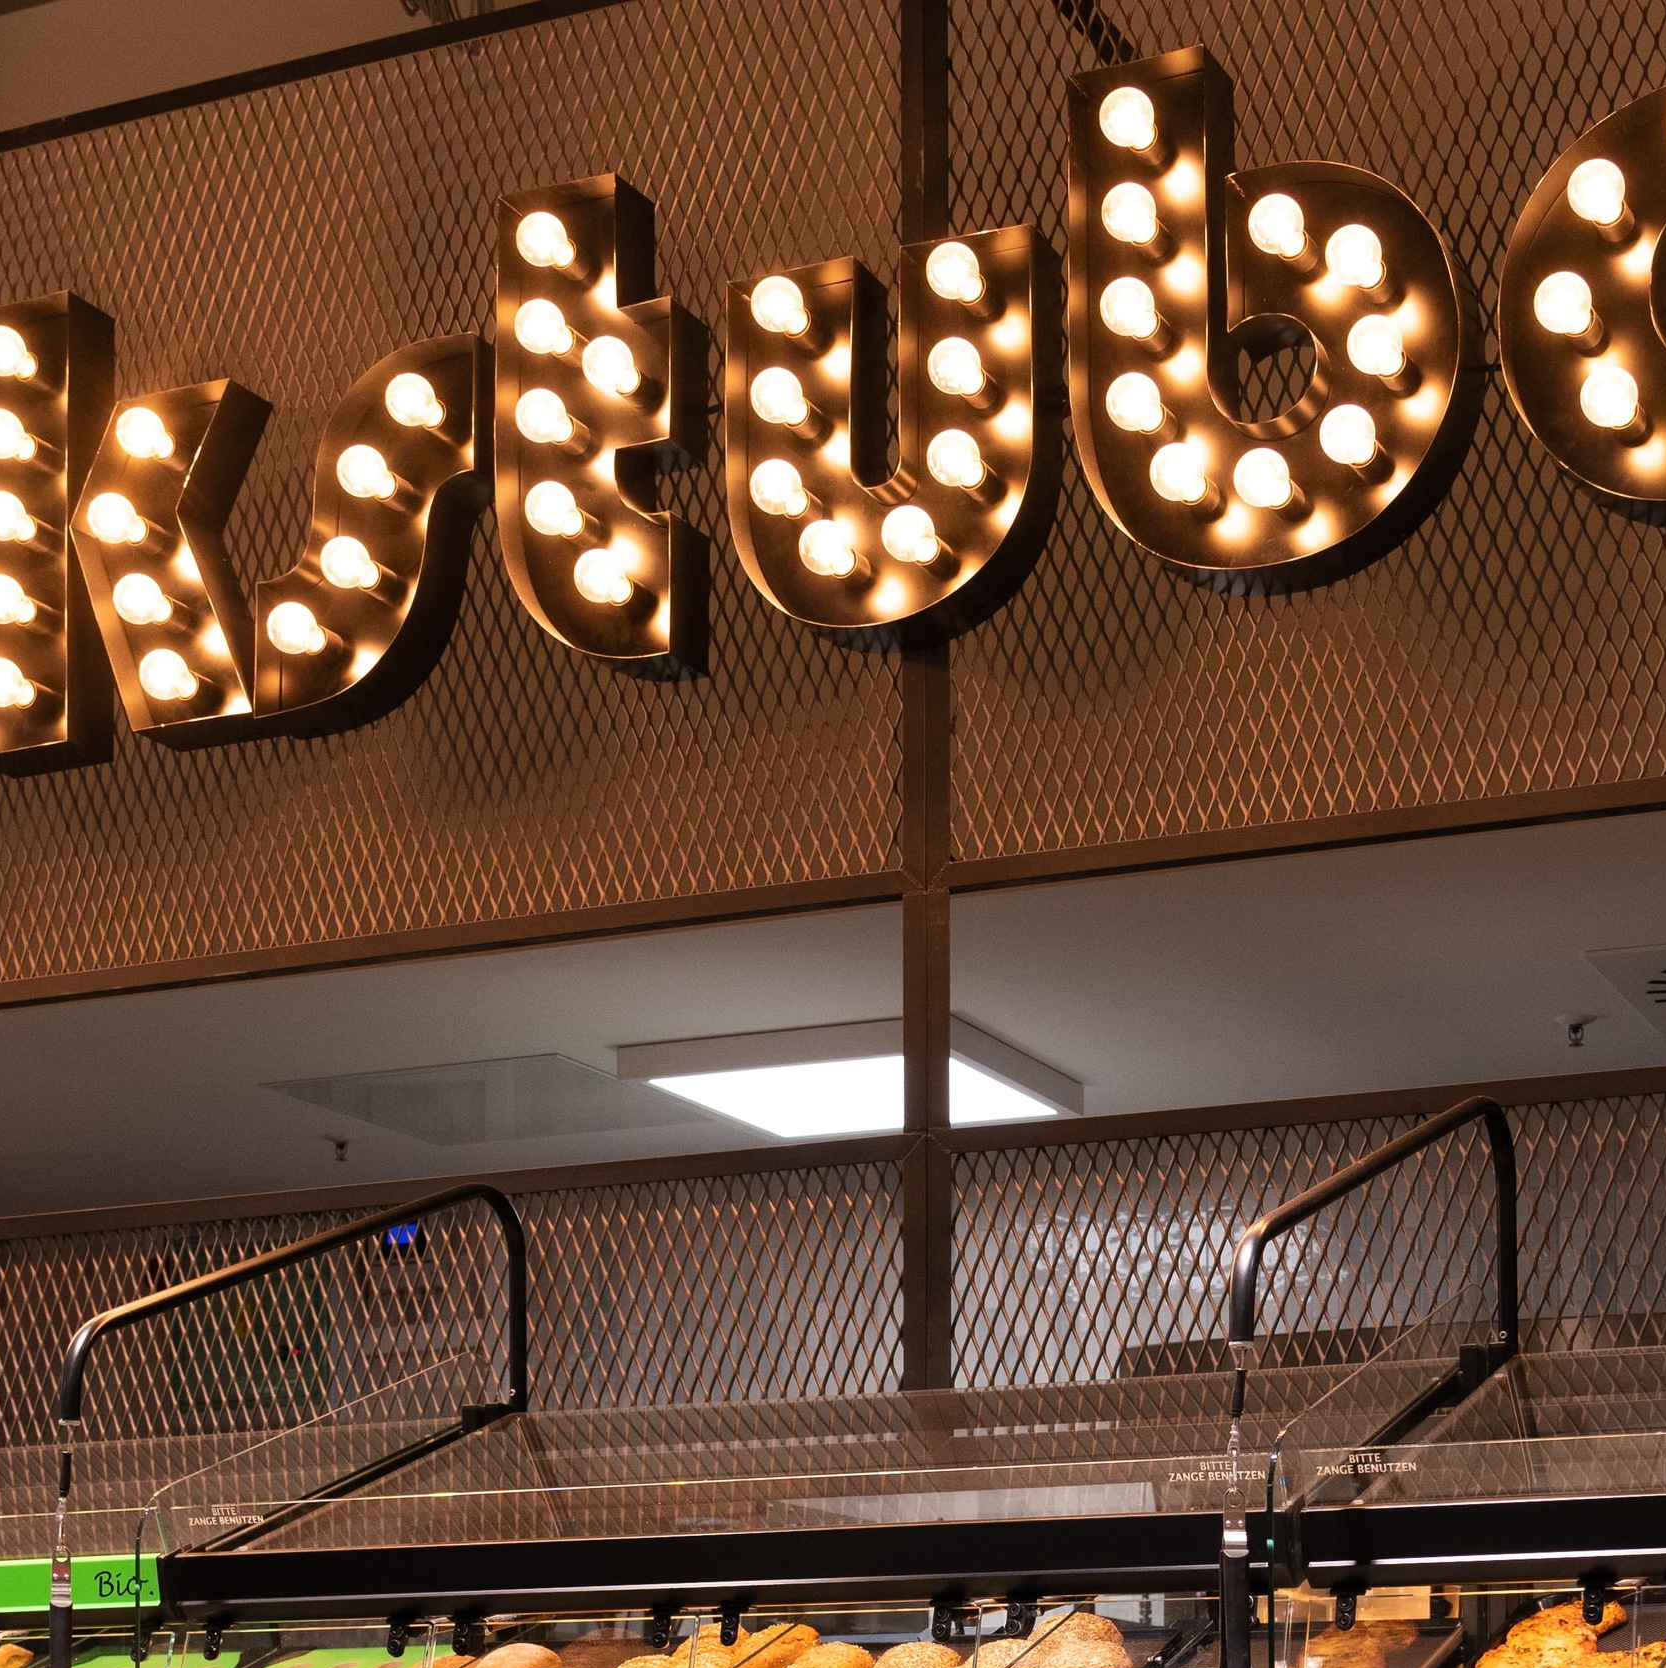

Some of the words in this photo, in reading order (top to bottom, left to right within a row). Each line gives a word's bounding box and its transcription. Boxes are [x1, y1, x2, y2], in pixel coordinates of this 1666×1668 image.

[1348, 1453, 1381, 1464] BITTE
[1200, 1461, 1231, 1471] BITTE
[1316, 1465, 1353, 1477] ZANGE
[1357, 1462, 1417, 1476] BENUTZEN
[1168, 1472, 1205, 1482] ZANGE
[211, 1508, 237, 1517] BITTE
[189, 1516, 217, 1526] ZANGE
[219, 1515, 264, 1525] BENUTZEN
[94, 1571, 149, 1597] Bio
